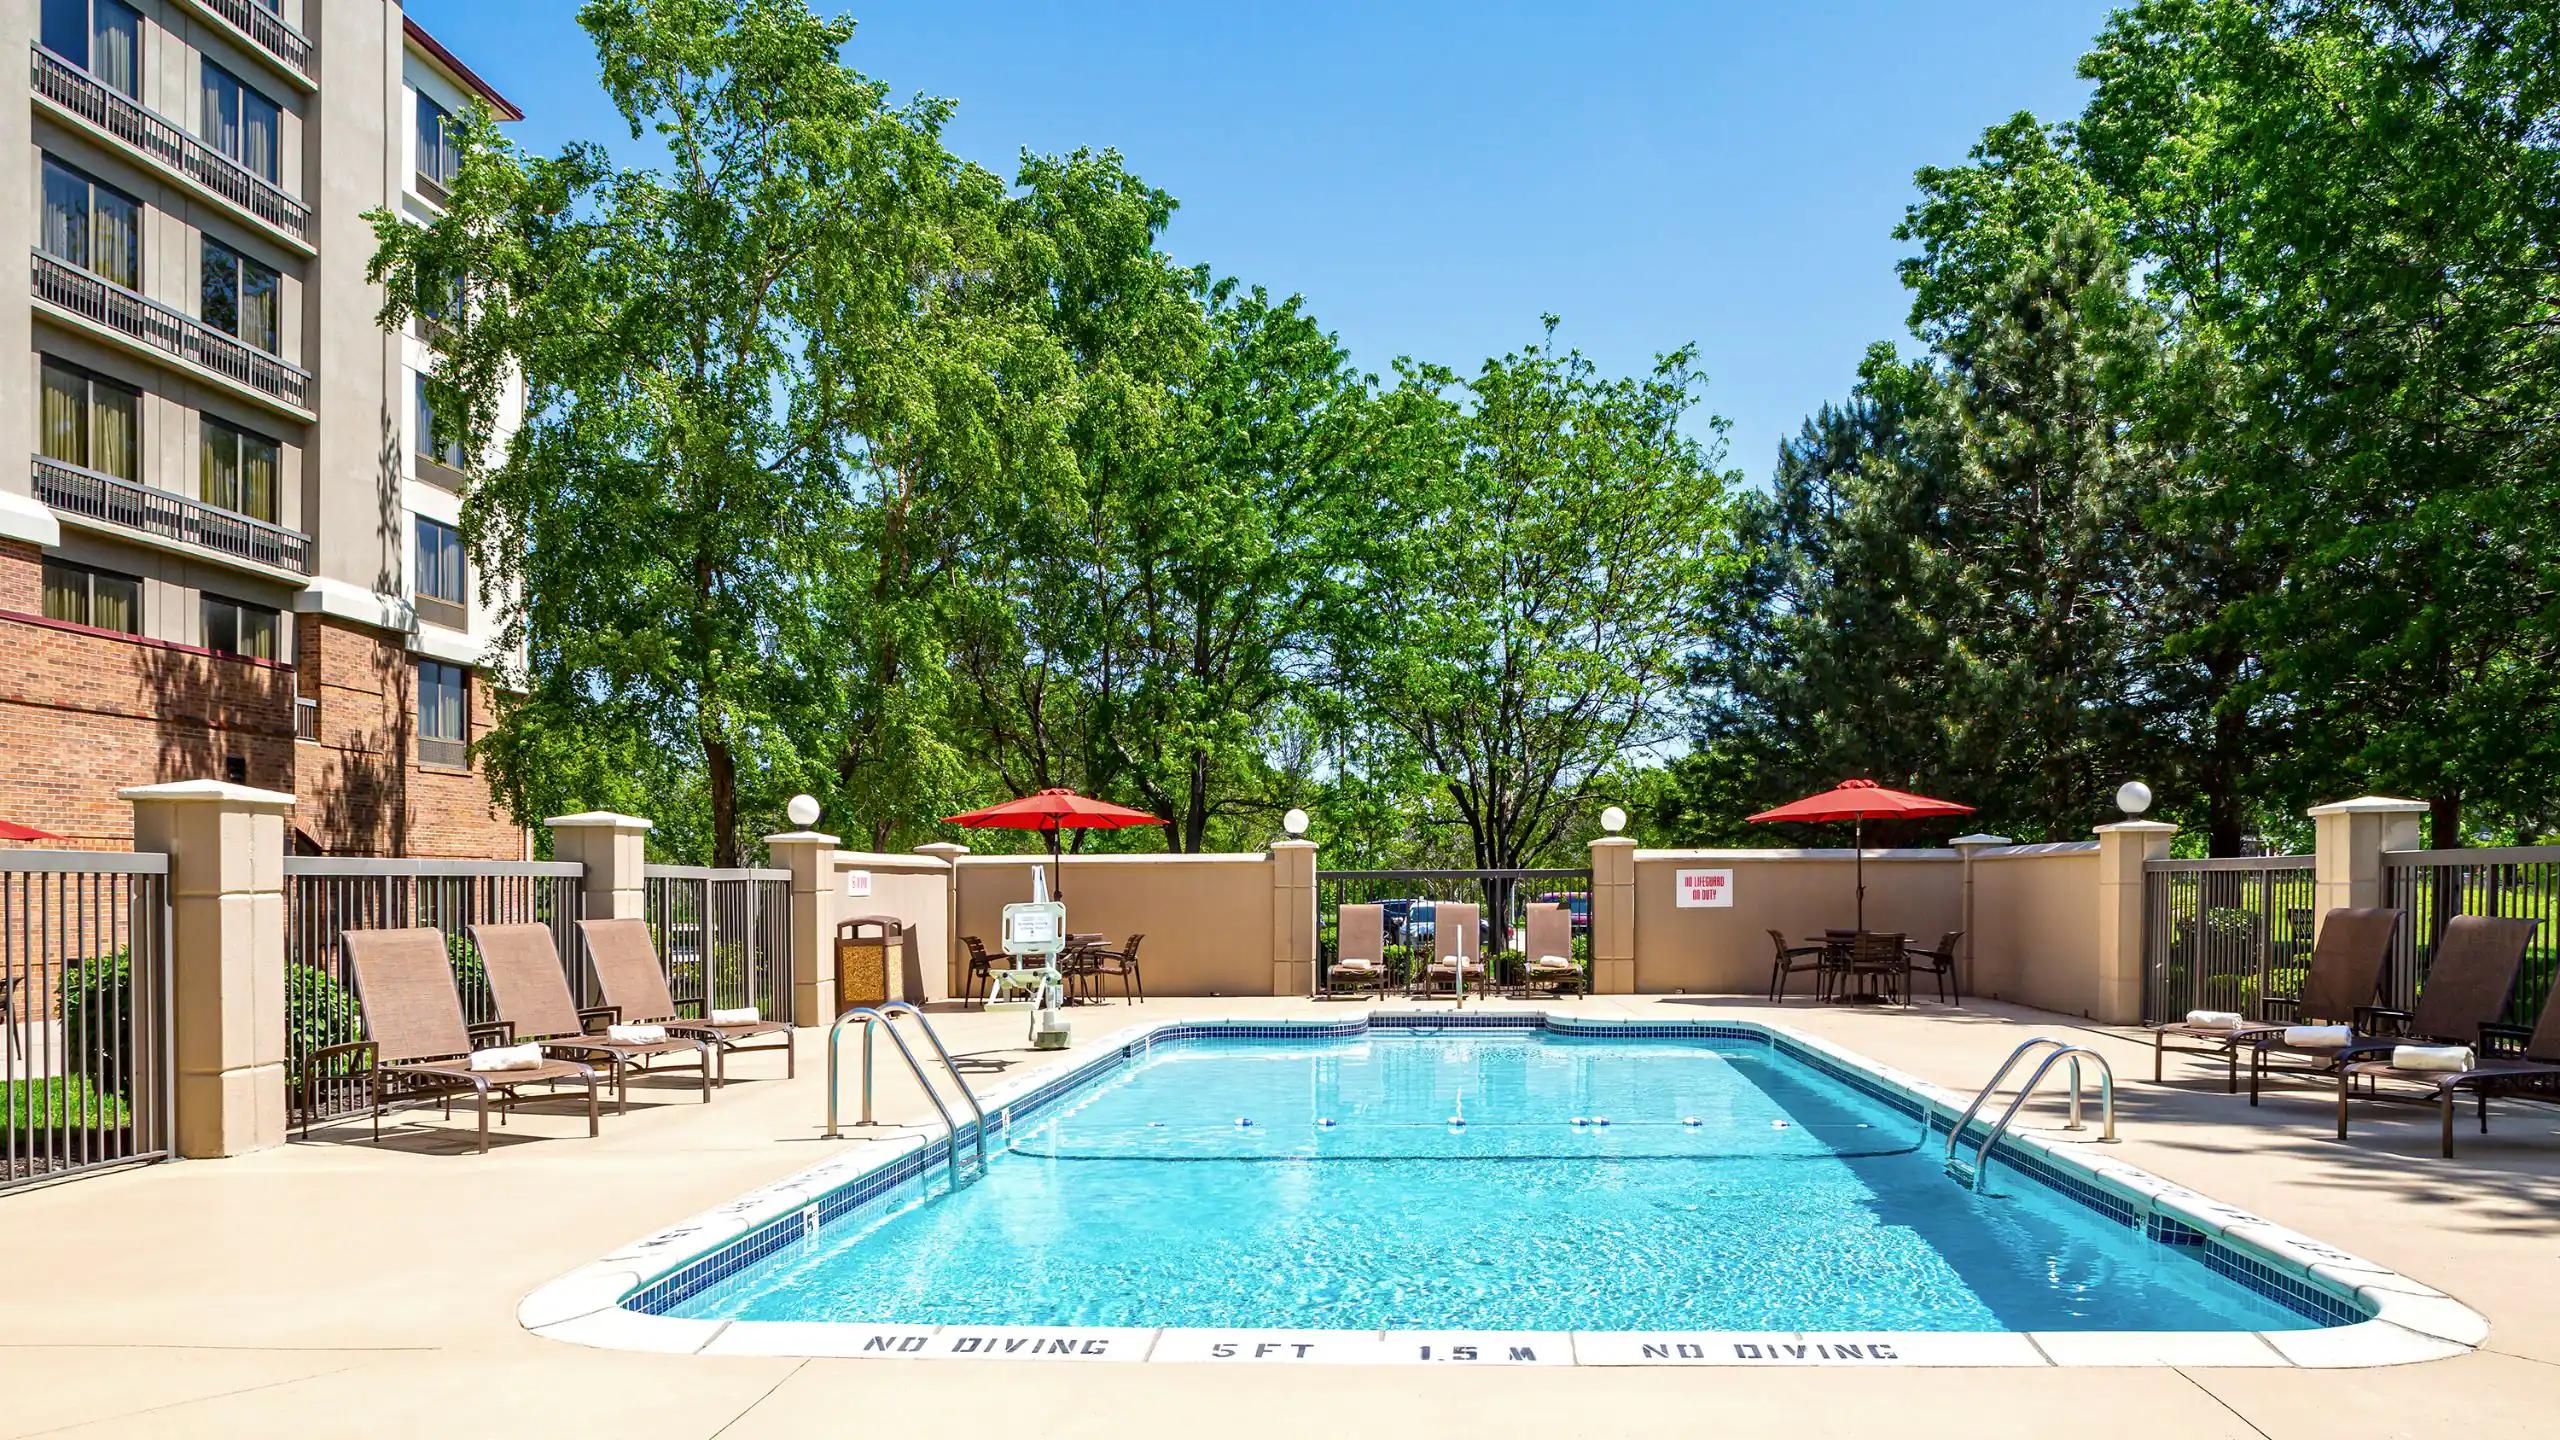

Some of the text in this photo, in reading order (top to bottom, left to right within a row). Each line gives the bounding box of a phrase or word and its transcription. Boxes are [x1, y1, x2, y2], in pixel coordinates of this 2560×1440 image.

[1694, 876, 1724, 887] LIFEGUARD
[1702, 889, 1716, 900] DUTY
[863, 1336, 1110, 1354] NO DIVING
[1419, 1345, 1537, 1361] 1.5 M
[1642, 1343, 1899, 1359] NO DIVING
